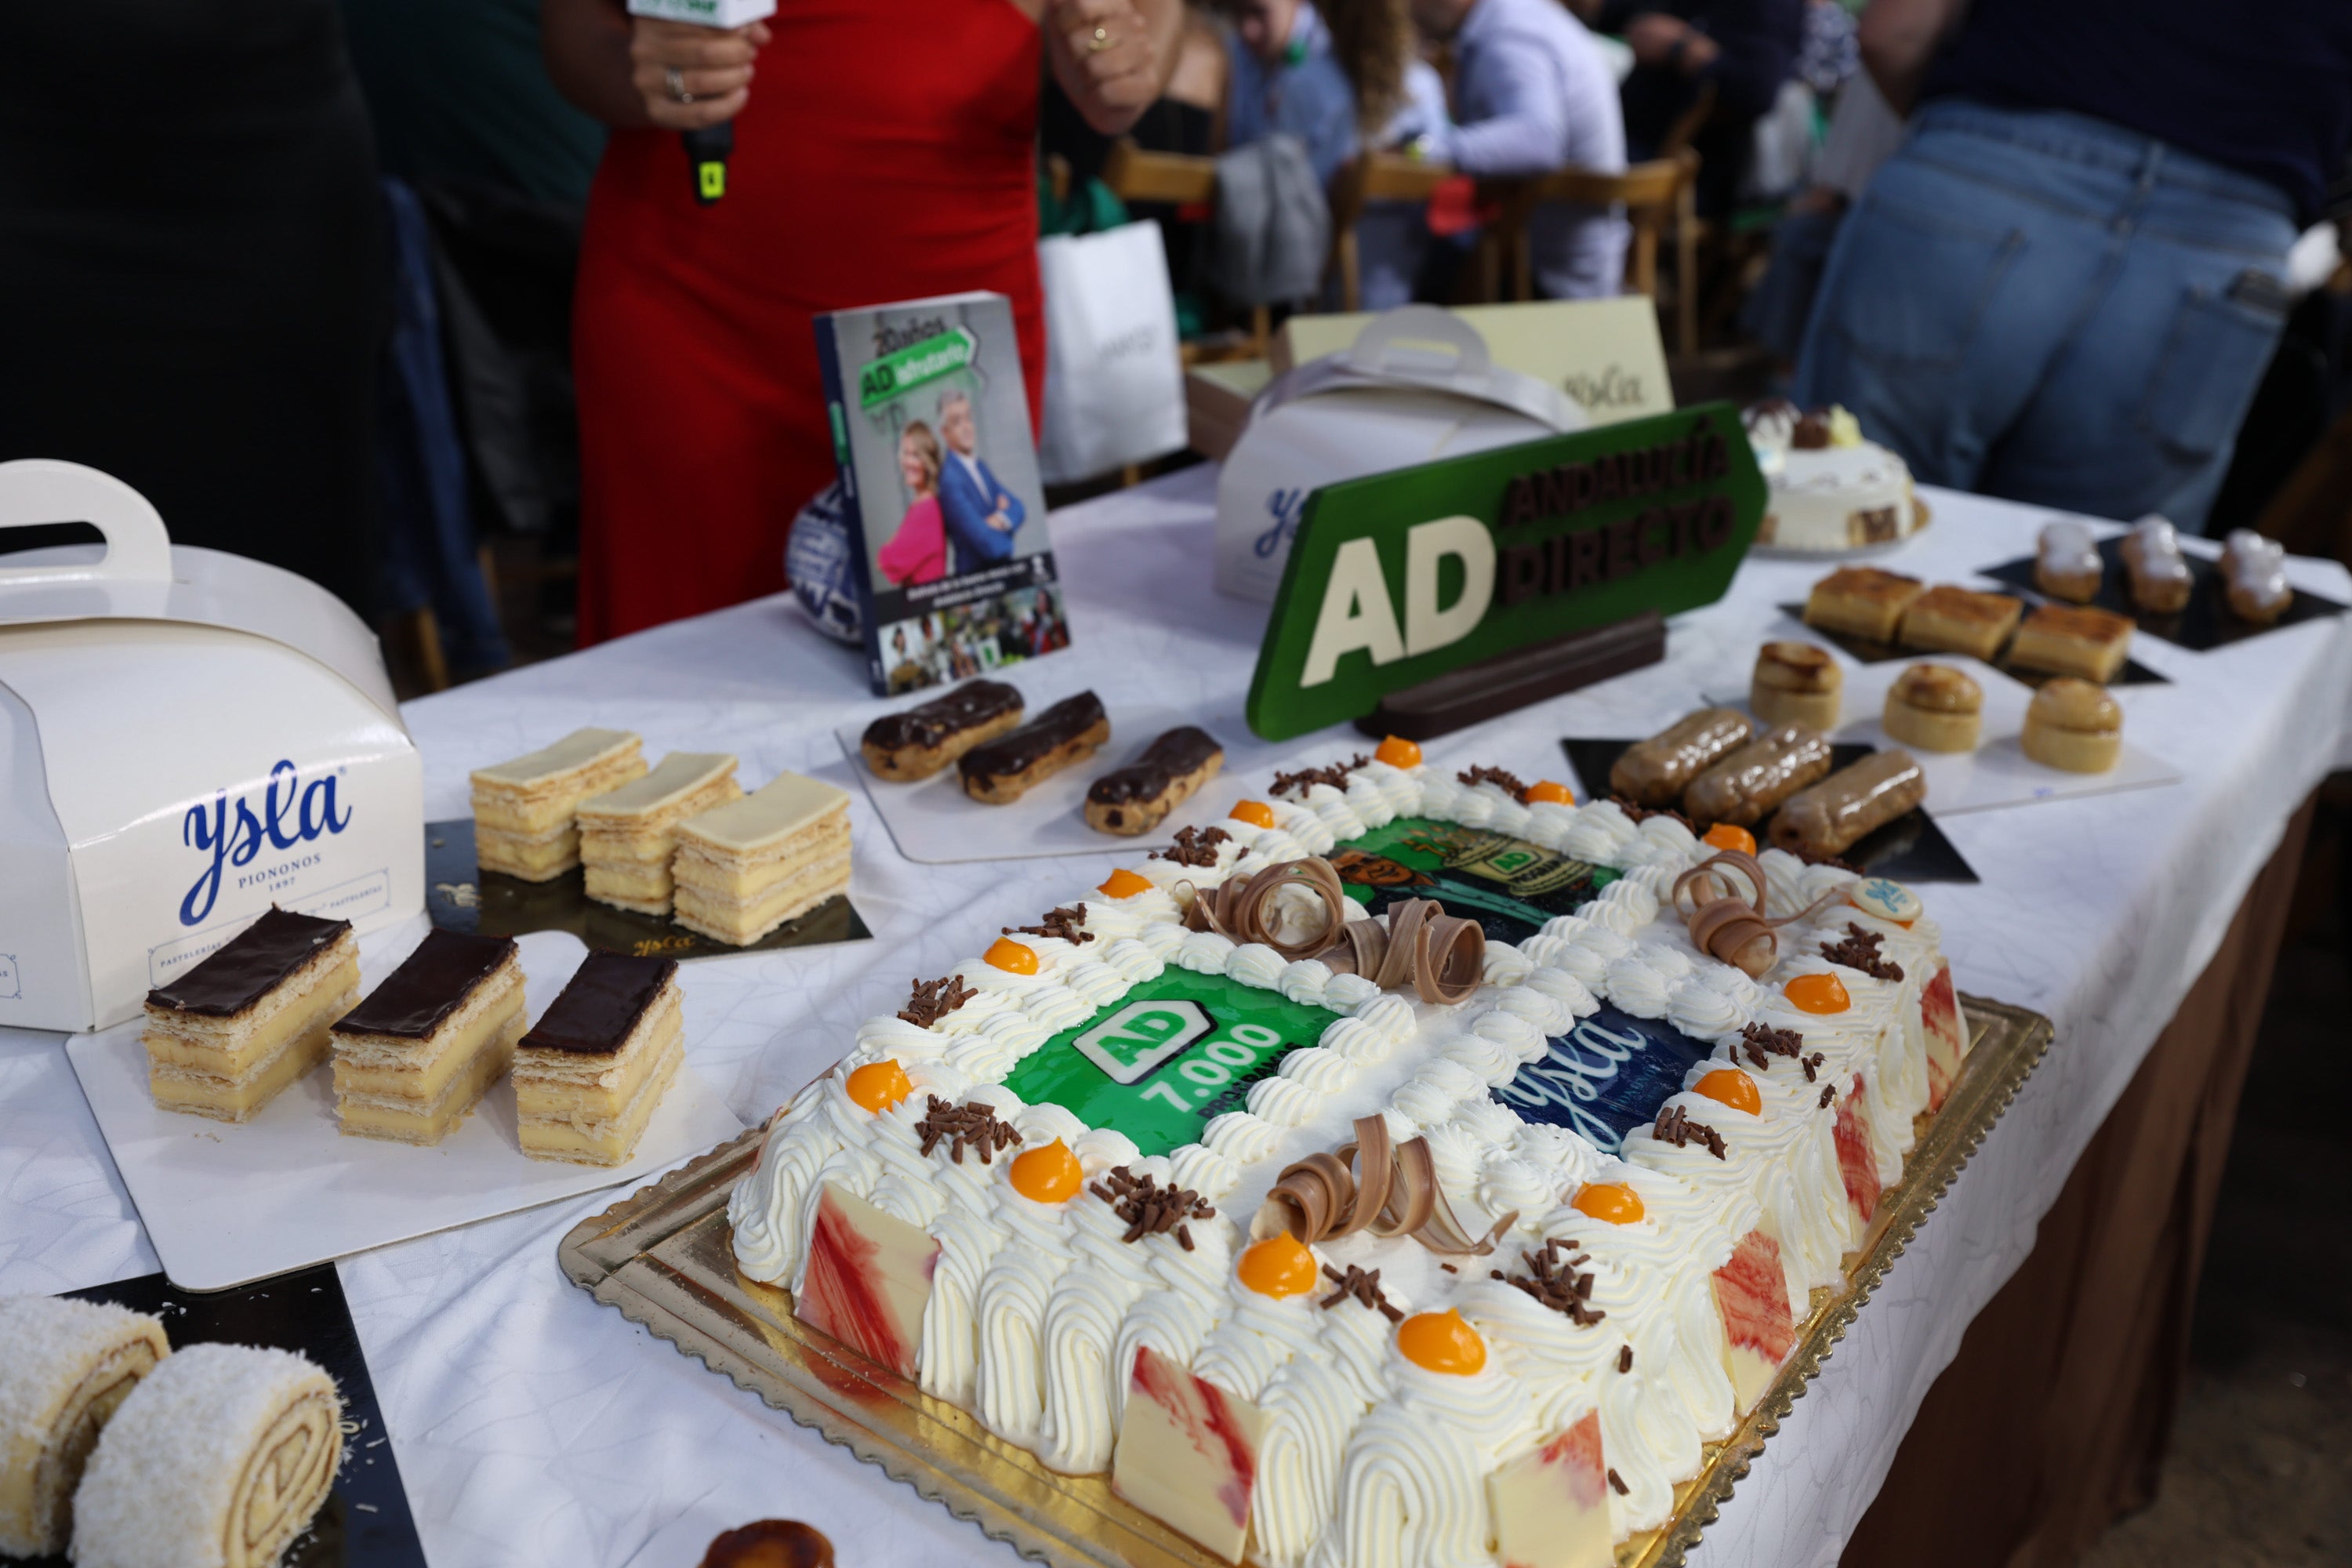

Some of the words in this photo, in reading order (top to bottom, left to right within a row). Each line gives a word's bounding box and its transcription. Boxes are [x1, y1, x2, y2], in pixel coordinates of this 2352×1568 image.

[1499, 414, 1730, 529] ANDALUCÍA
[1300, 514, 1497, 688] AD
[1496, 494, 1735, 605] DIRECTO
[238, 853, 322, 889] PIONONOS
[269, 877, 296, 892] 1897
[1096, 1010, 1187, 1068] AD
[1138, 1023, 1282, 1113] 7.000
